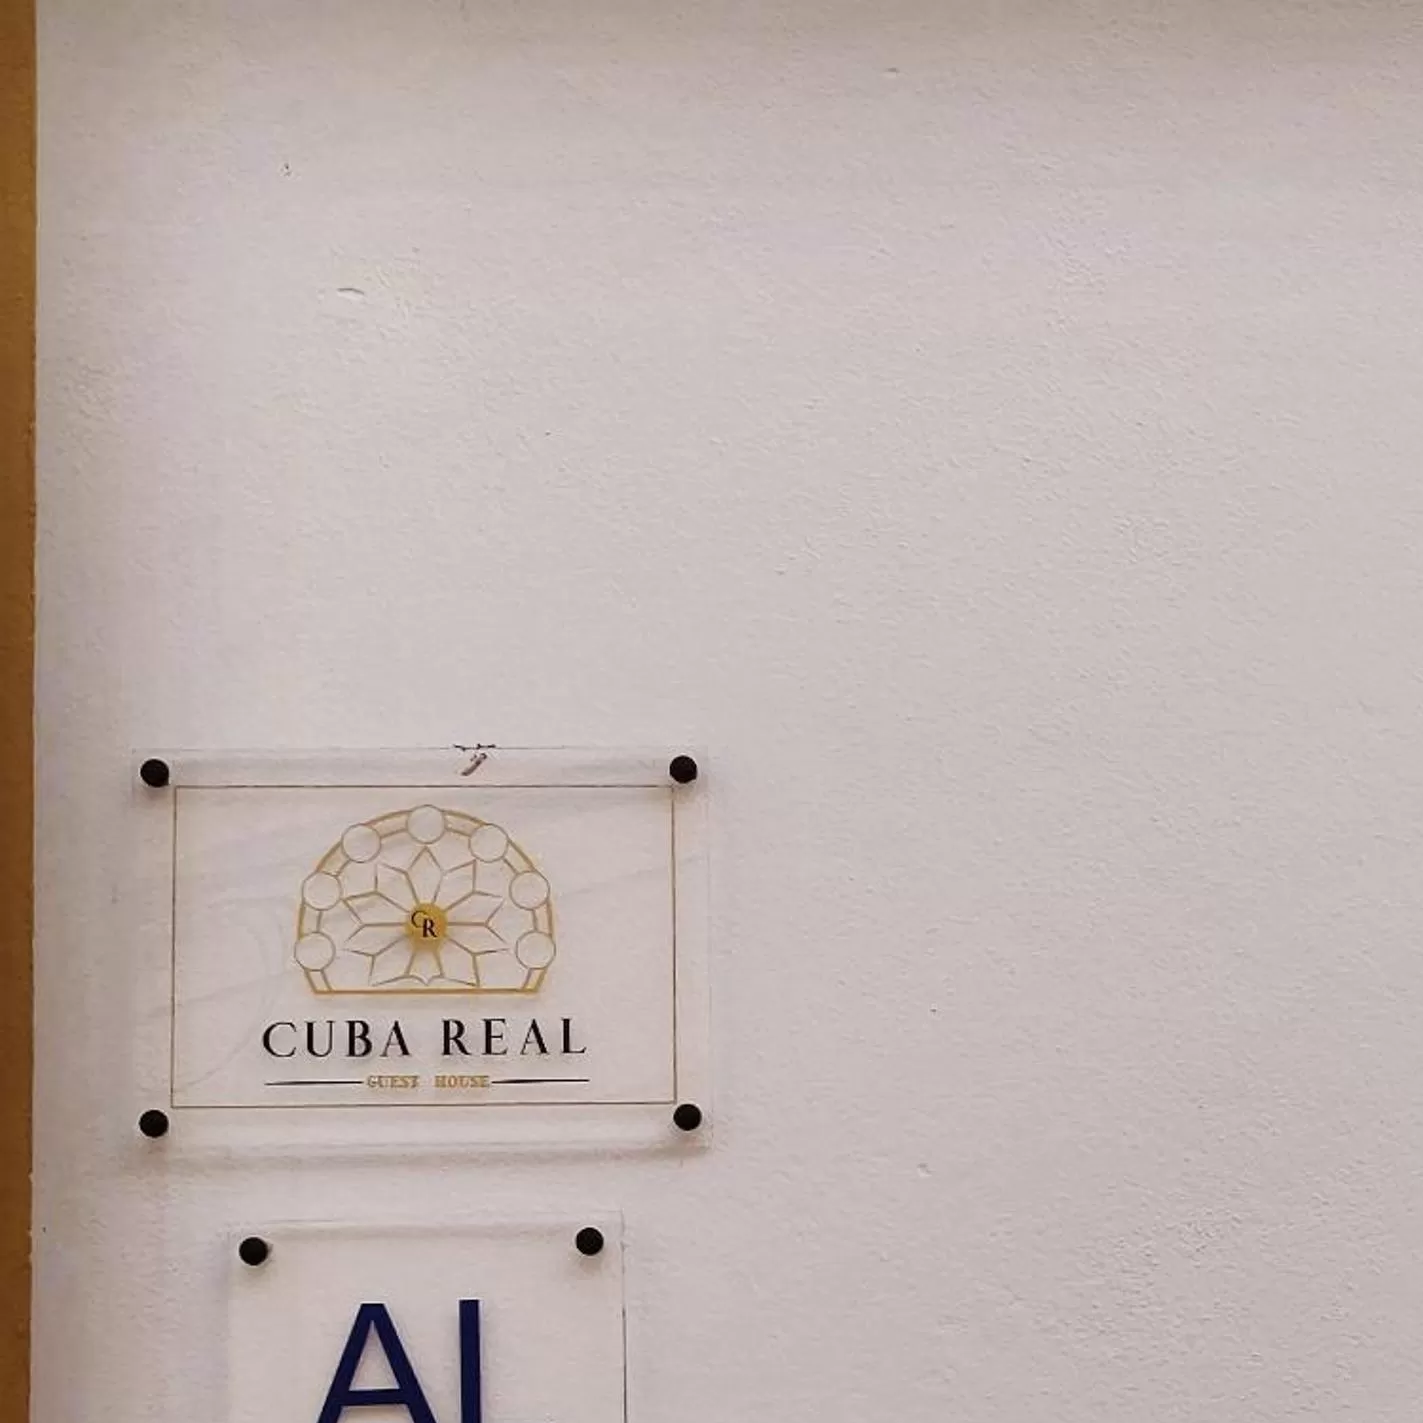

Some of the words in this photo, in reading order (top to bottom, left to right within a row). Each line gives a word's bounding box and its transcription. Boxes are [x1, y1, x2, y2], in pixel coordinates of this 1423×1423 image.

[262, 1020, 411, 1059] CUBA
[441, 1018, 588, 1056] REAL
[366, 1074, 420, 1088] GUEST
[434, 1074, 490, 1088] HOUSE
